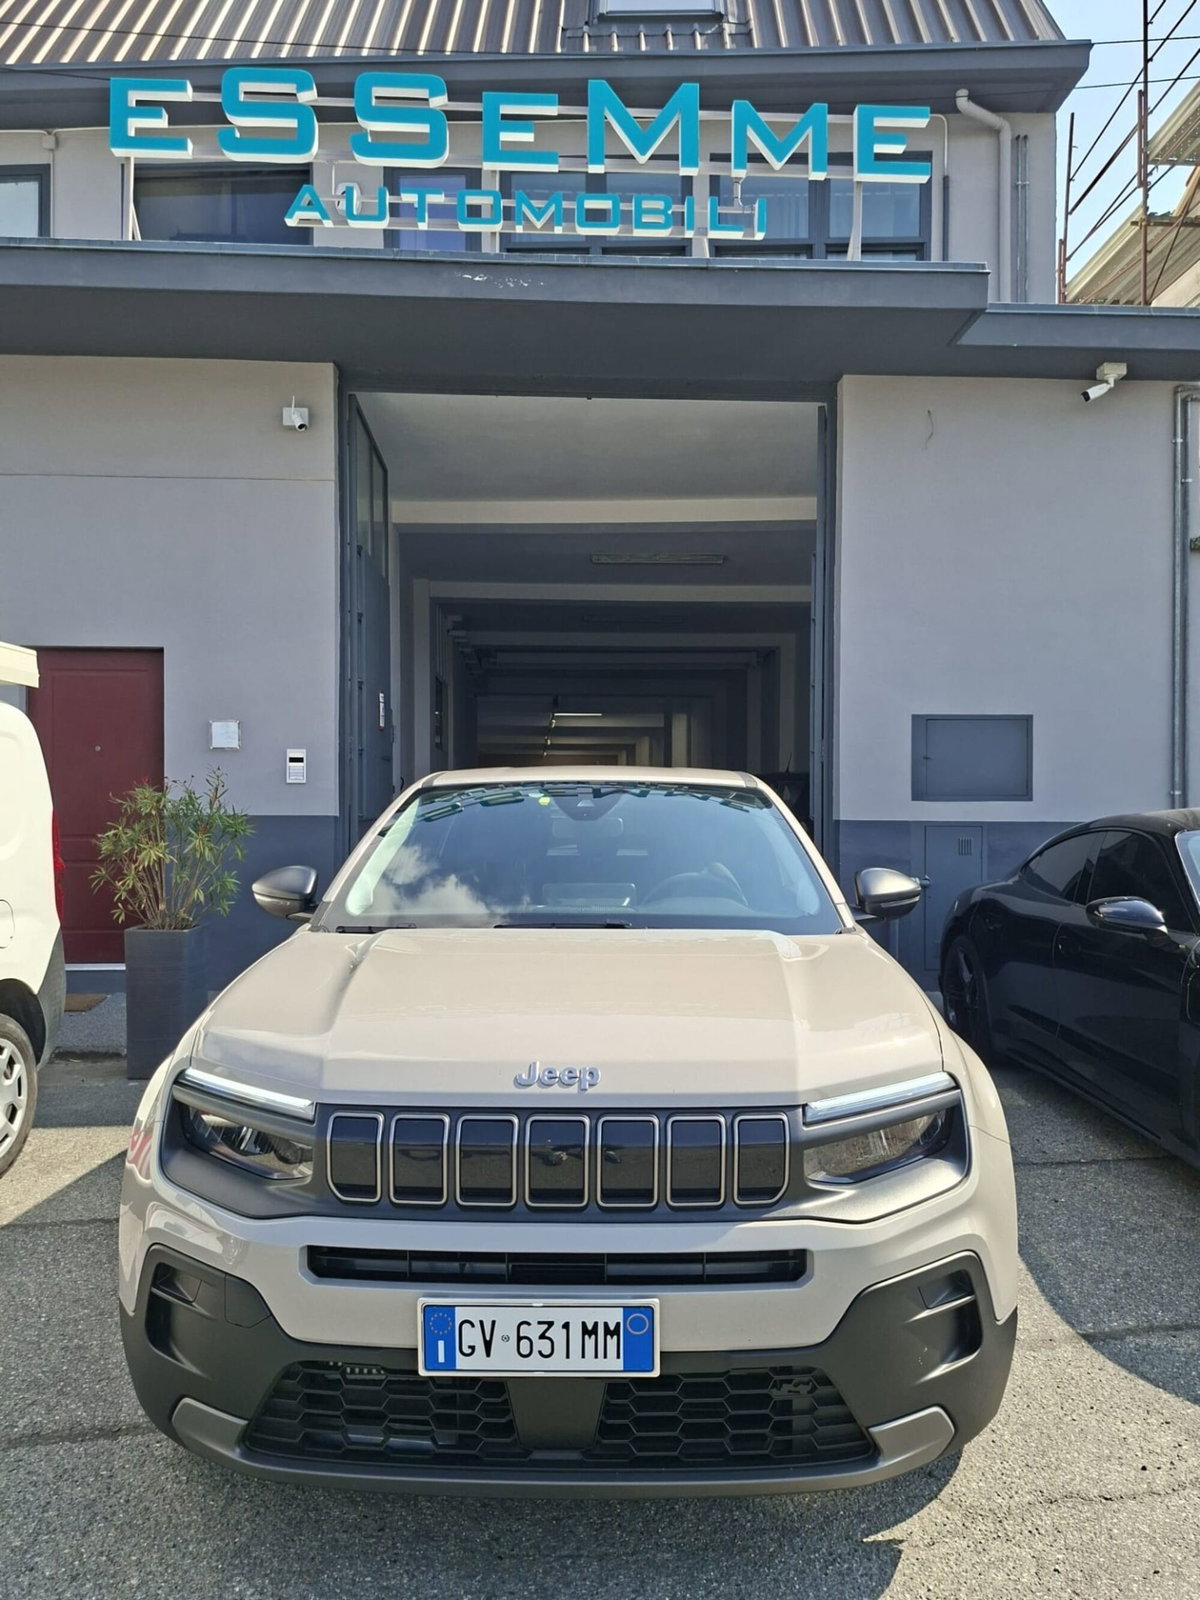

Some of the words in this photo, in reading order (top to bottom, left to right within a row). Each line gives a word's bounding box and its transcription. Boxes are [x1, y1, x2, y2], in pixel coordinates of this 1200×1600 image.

[109, 67, 932, 184] ESSEMME
[284, 184, 767, 240] AUTOMOBILI
[514, 1060, 601, 1093] Jeep
